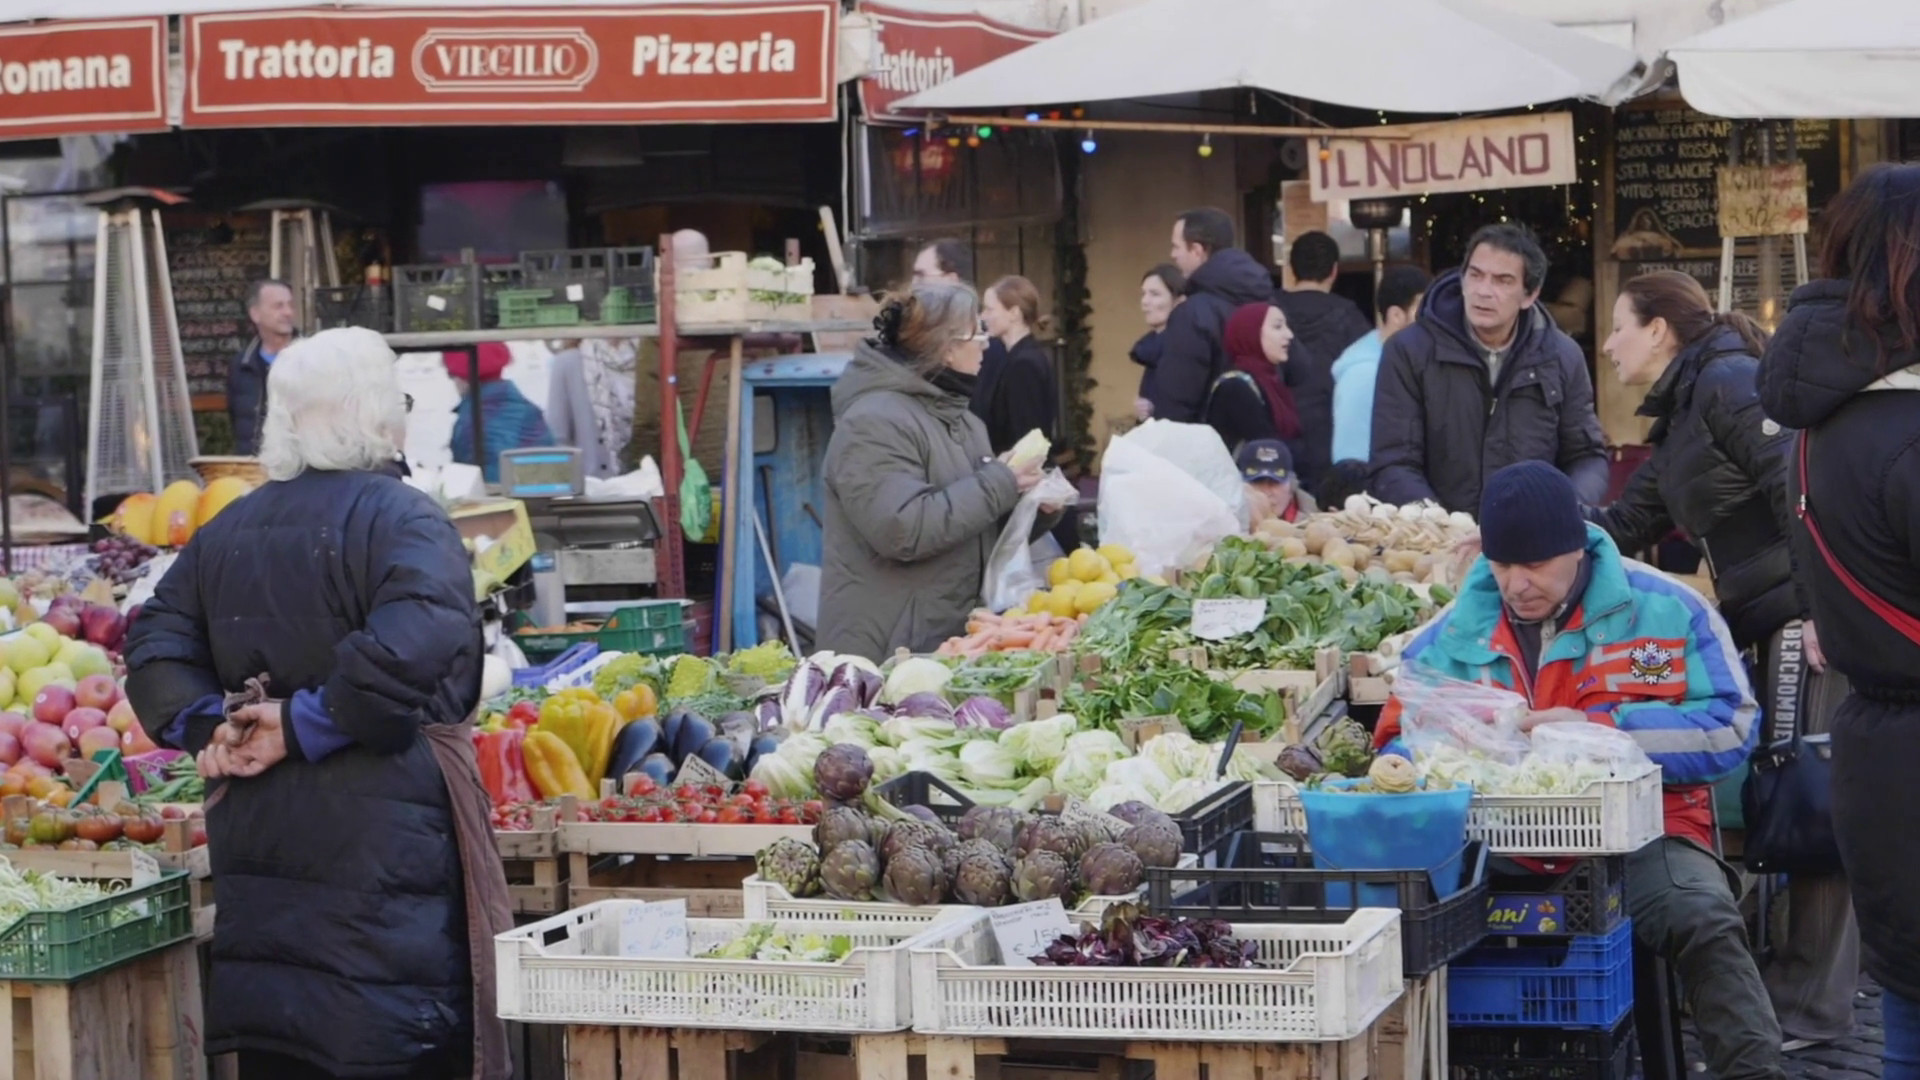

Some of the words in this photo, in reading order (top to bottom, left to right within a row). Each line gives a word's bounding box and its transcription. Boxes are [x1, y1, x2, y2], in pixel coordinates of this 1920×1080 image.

[0, 53, 131, 95] omana
[219, 37, 395, 80] Trattoria
[435, 44, 577, 76] VIRGILIO
[632, 31, 797, 77] Pizzeria
